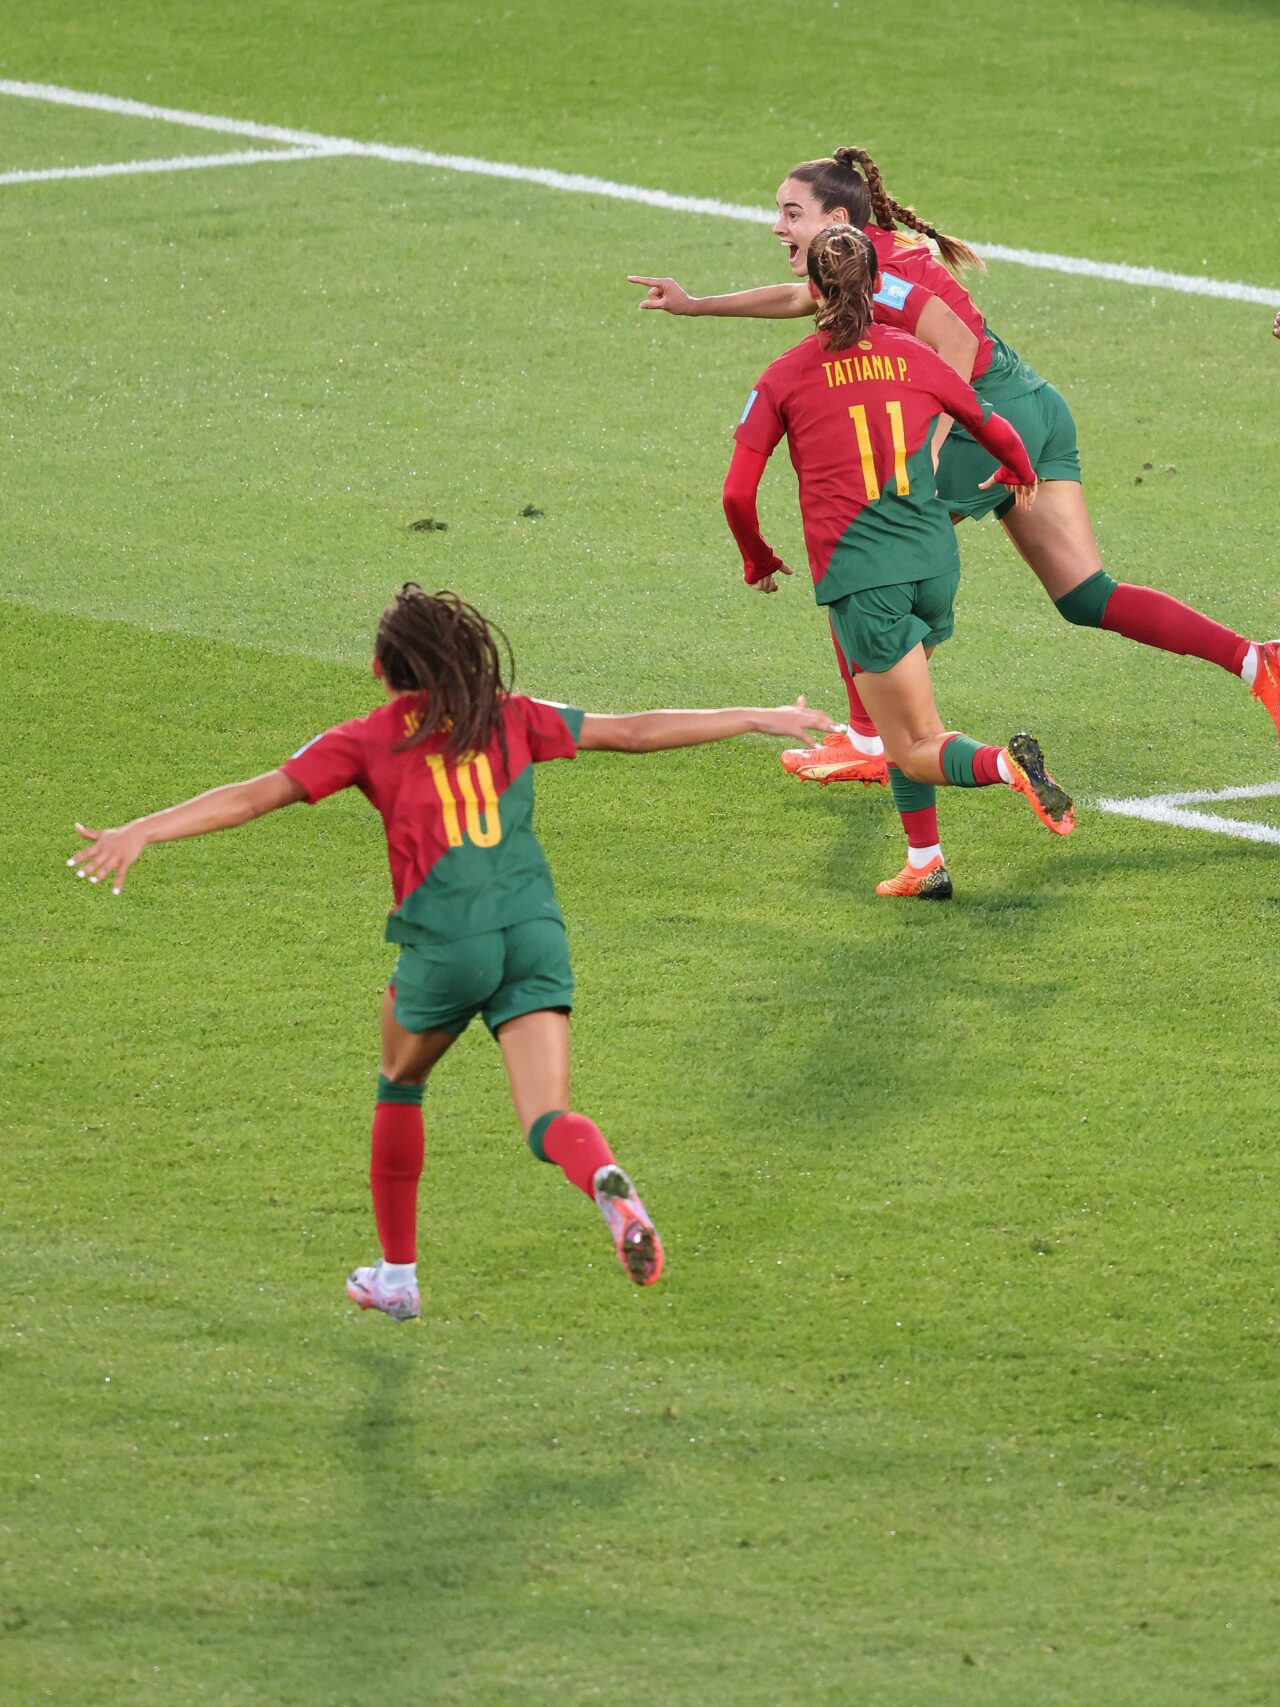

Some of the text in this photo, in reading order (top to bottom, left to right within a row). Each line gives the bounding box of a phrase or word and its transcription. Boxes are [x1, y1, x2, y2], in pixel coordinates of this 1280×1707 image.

[821, 355, 912, 388] TATIANA P.
[848, 401, 911, 501] 11
[425, 750, 503, 848] 10
